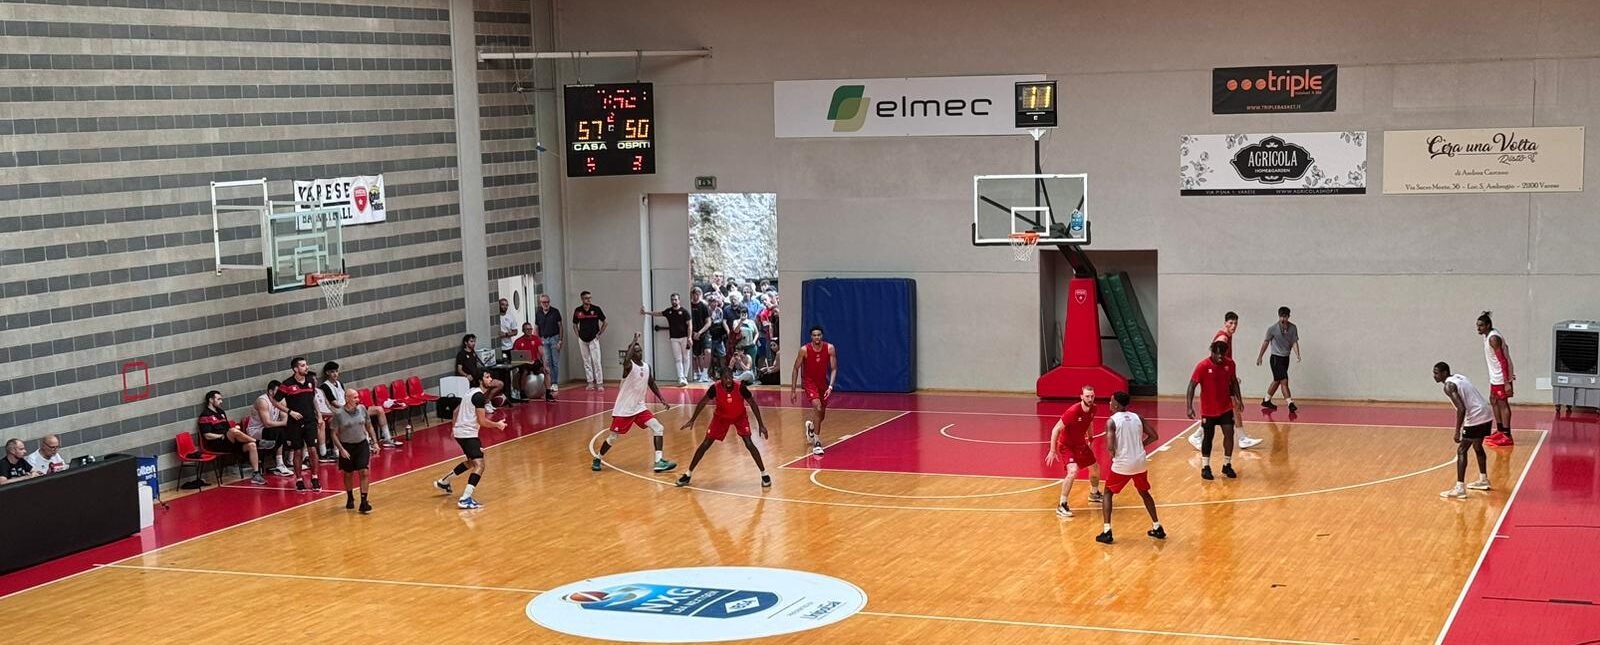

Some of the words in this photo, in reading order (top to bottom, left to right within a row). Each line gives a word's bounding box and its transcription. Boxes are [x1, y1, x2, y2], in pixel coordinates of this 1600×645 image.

[1268, 69, 1323, 98] triple
[876, 95, 993, 118] elmec
[578, 120, 603, 140] 57
[625, 119, 650, 139] 50
[573, 143, 608, 151] CASA
[617, 141, 651, 150] OSPITI
[1465, 142, 1494, 153] una
[1492, 132, 1540, 152] Volta
[1247, 150, 1298, 167] AGRICOLA
[297, 182, 351, 202] VARESE
[136, 464, 156, 477] olten
[632, 588, 702, 613] NXG
